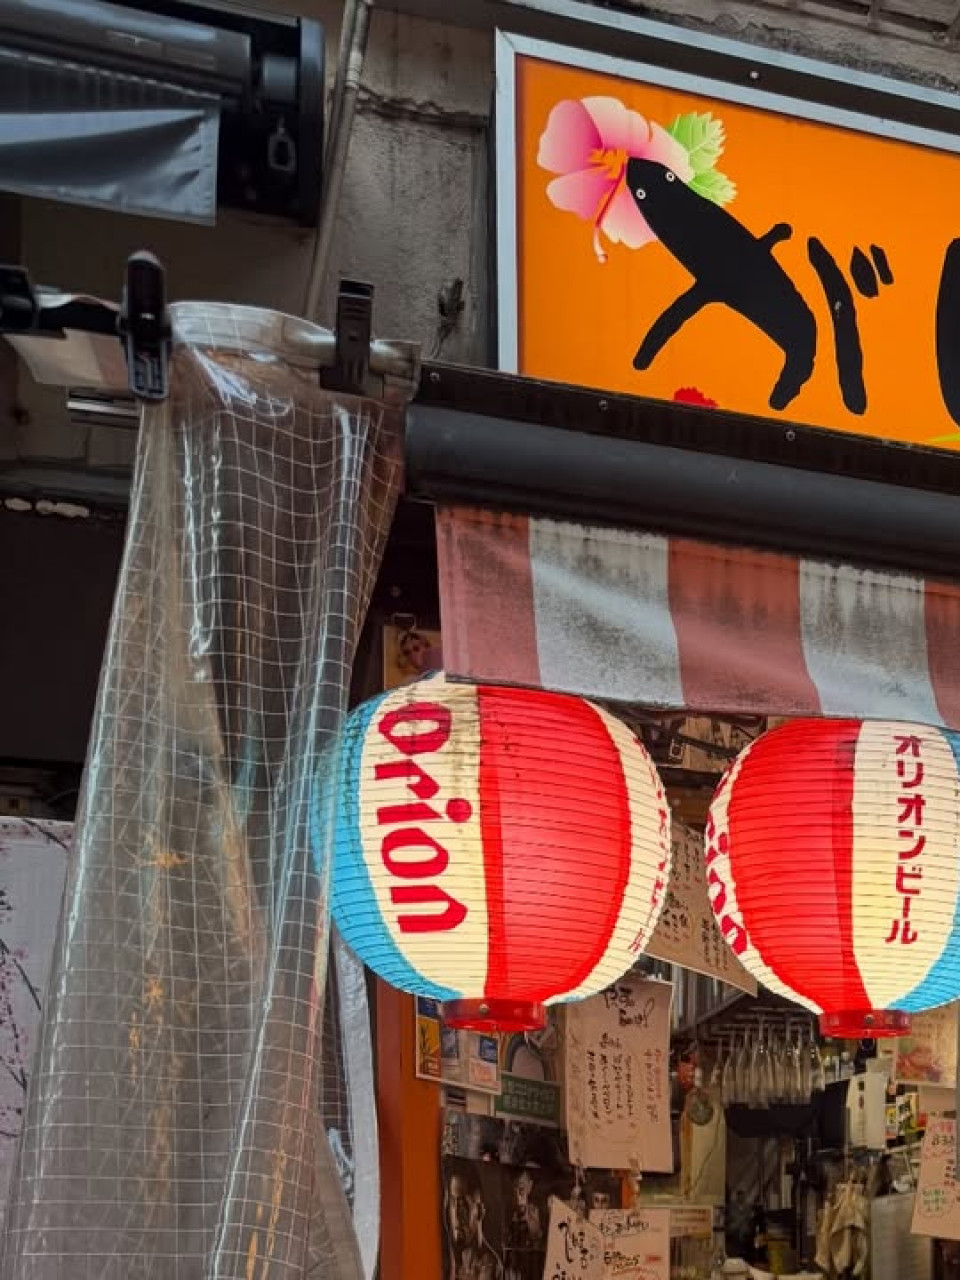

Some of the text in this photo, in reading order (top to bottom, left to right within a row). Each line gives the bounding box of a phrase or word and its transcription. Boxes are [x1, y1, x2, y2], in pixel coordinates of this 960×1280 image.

[885, 734, 928, 944] オリオンビール
